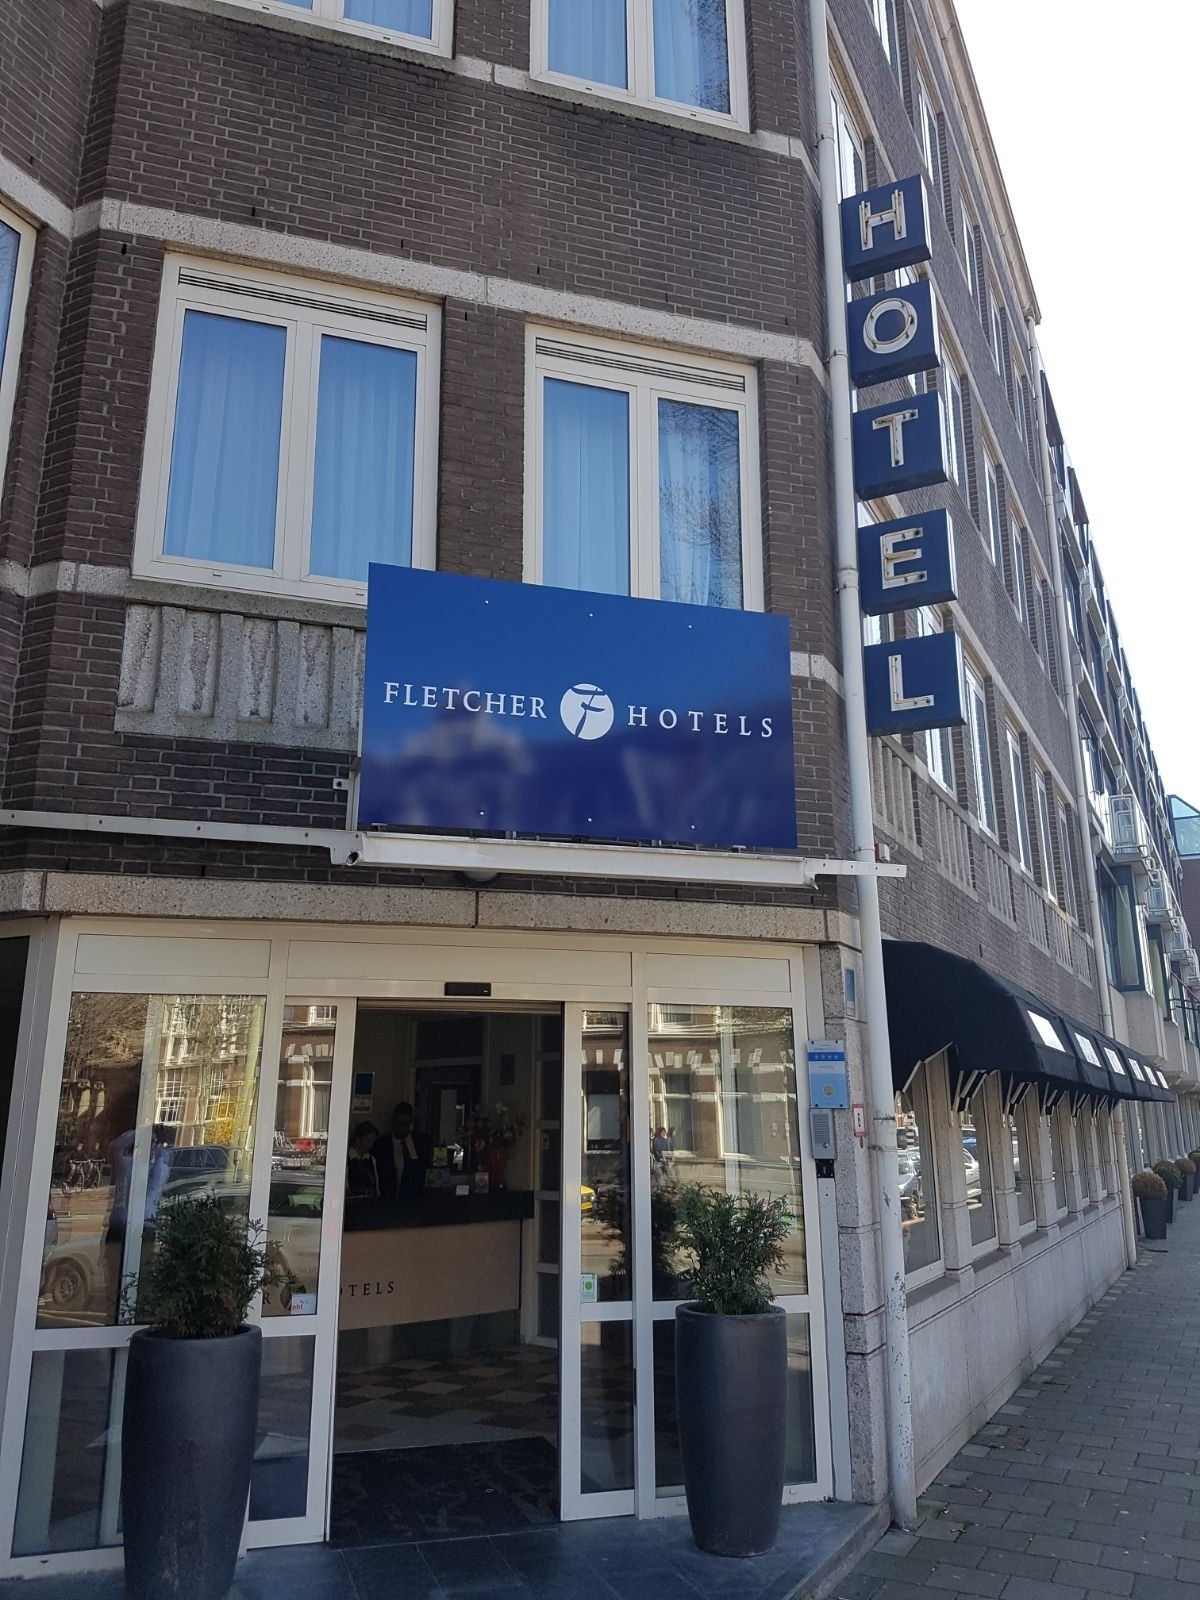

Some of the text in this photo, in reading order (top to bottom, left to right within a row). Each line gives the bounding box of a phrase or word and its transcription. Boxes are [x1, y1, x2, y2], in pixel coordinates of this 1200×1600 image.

[859, 189, 935, 712] HOTEL
[382, 681, 547, 719] FLETCHER
[627, 705, 774, 738] HOTELS
[340, 1281, 394, 1297] TELS
